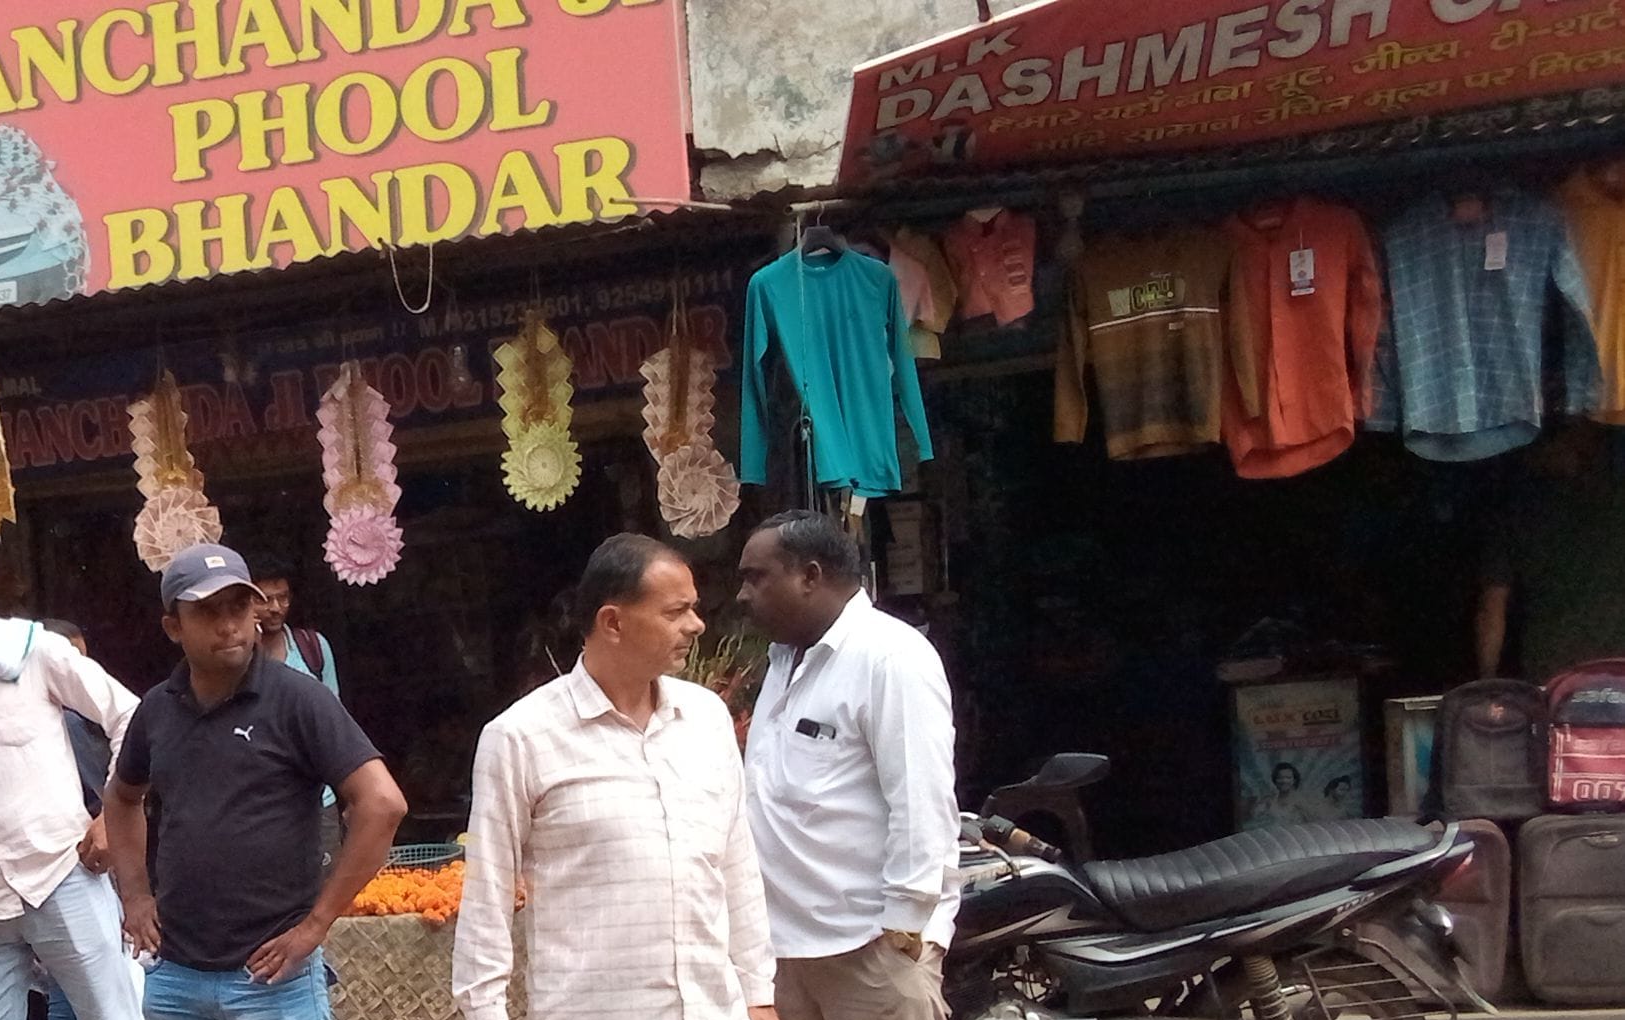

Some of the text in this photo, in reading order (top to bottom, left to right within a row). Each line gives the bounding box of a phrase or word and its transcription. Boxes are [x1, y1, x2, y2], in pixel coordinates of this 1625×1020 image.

[169, 47, 553, 183] PHOOL
[876, 0, 1390, 130] DASHMESH
[103, 134, 638, 293] BHANDAR
